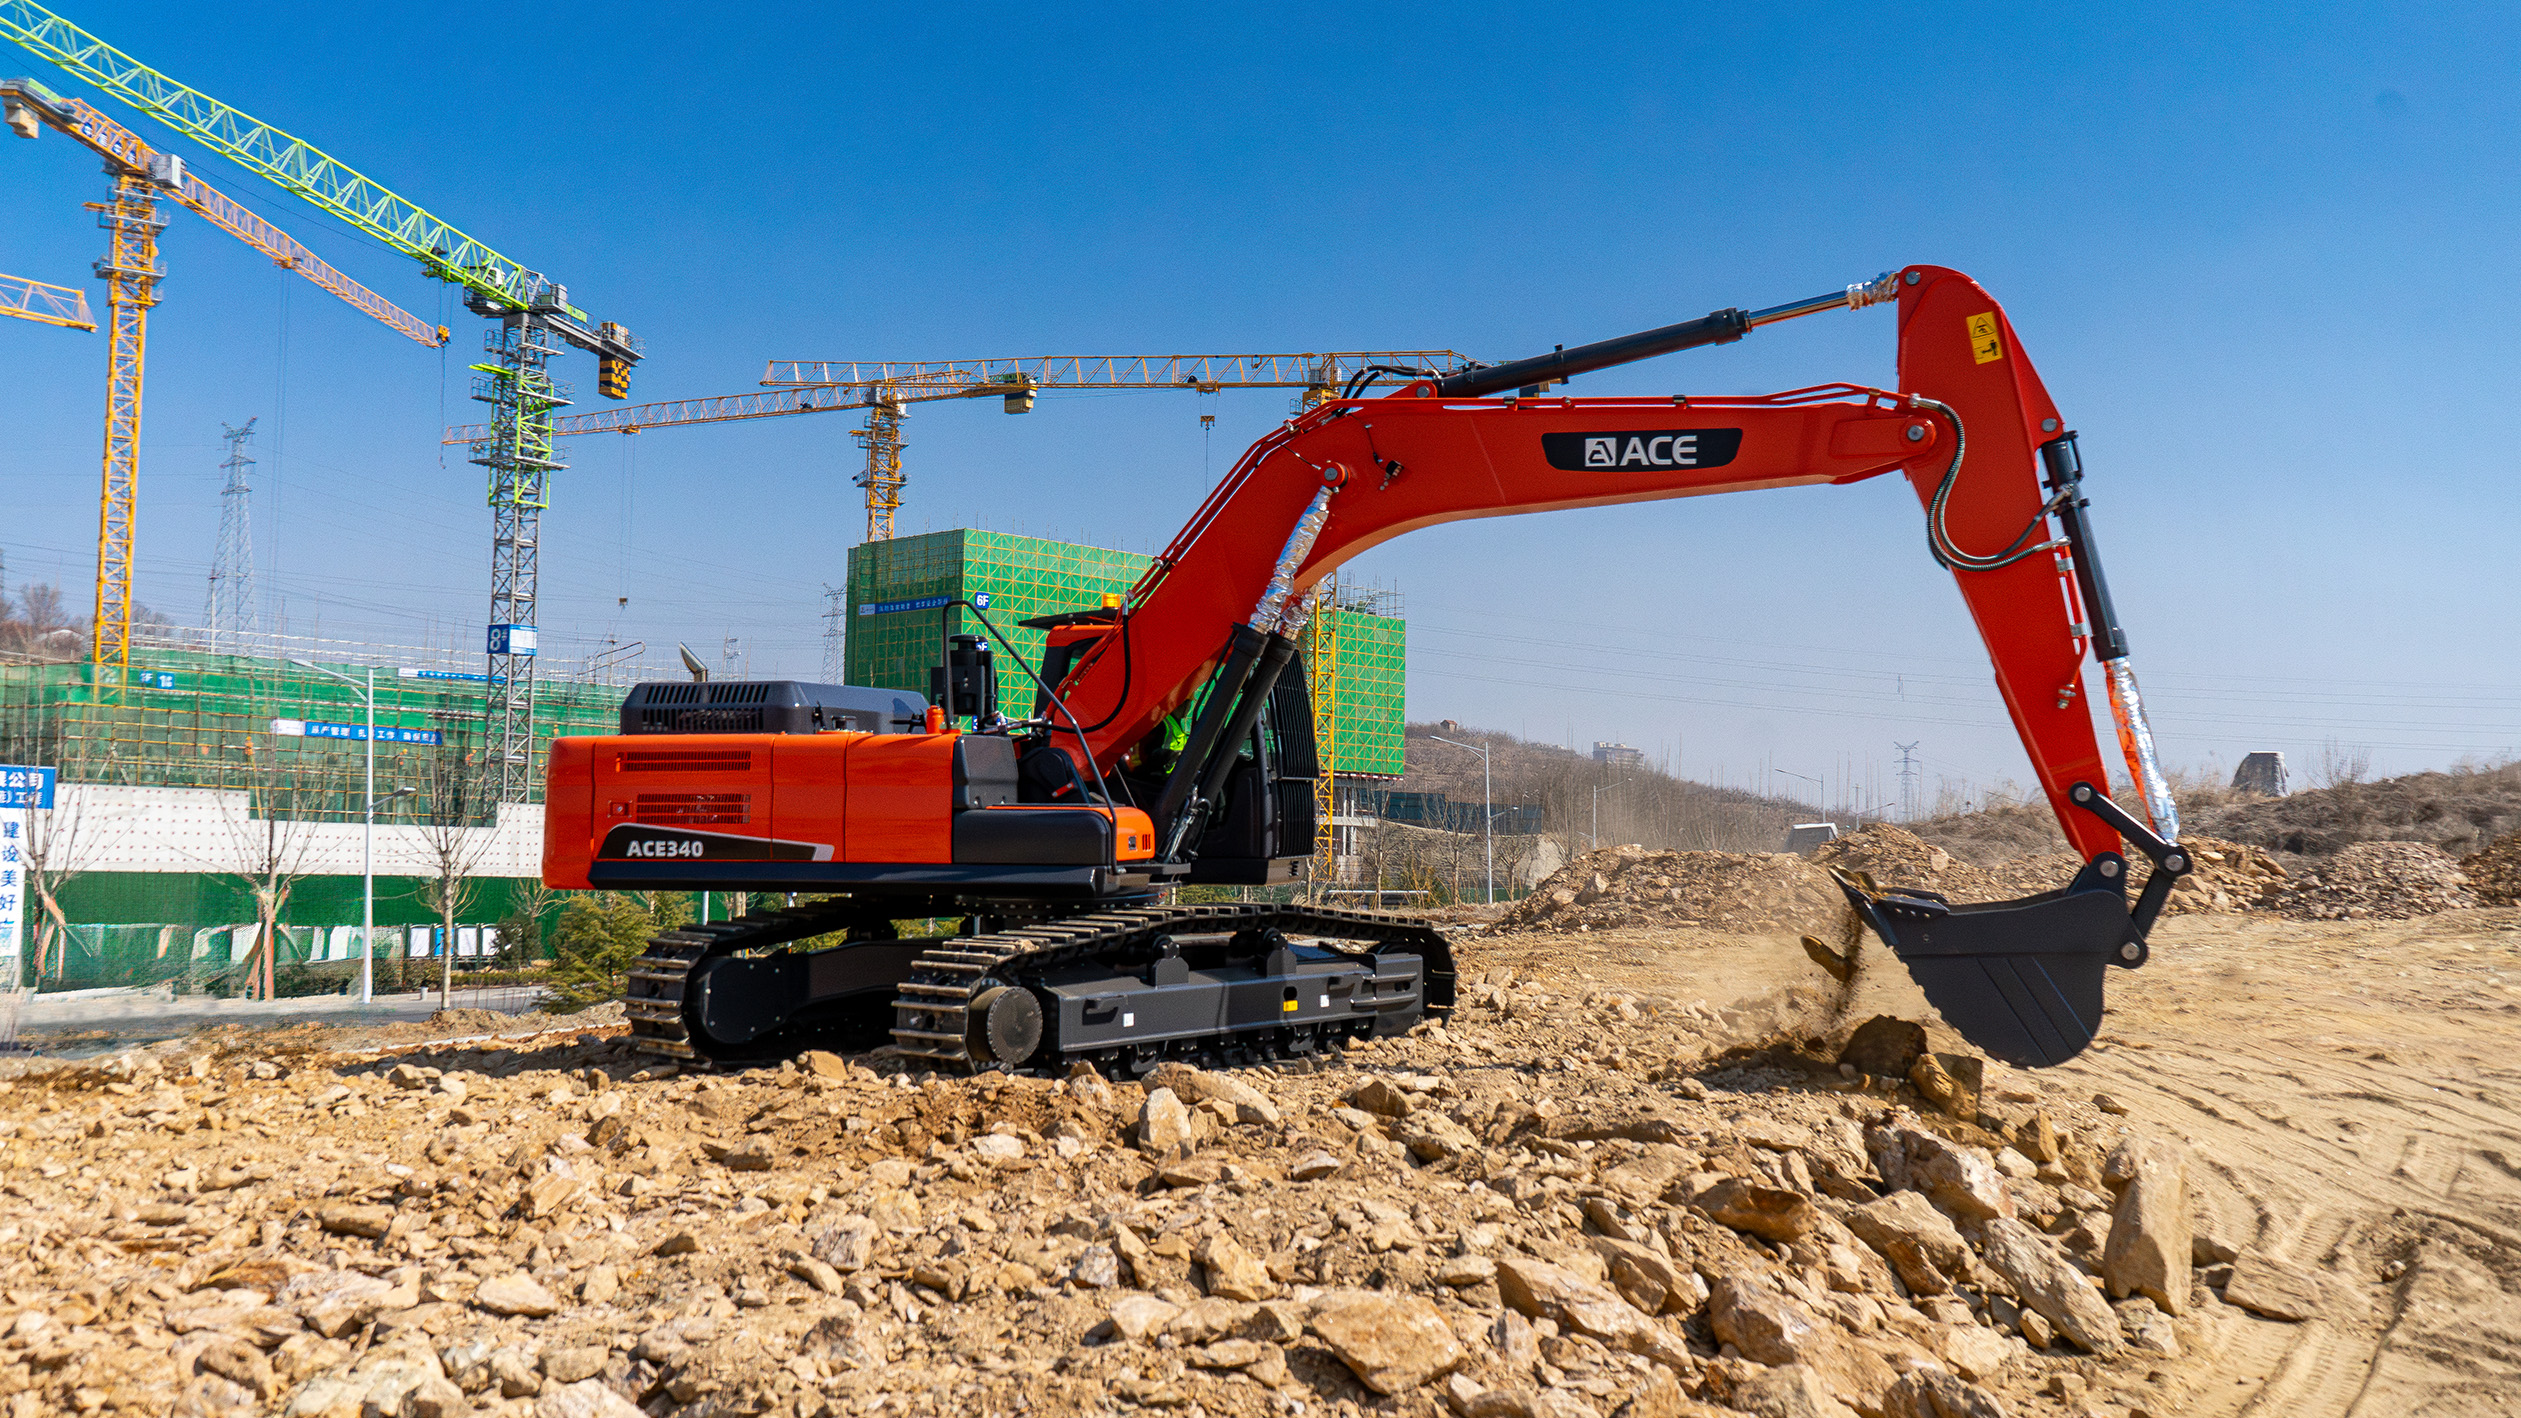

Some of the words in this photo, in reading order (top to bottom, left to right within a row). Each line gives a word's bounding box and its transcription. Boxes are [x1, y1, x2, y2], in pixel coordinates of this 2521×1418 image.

[1619, 435, 1697, 466] ACE
[977, 594, 989, 607] 6F
[627, 840, 704, 858] ACE340
